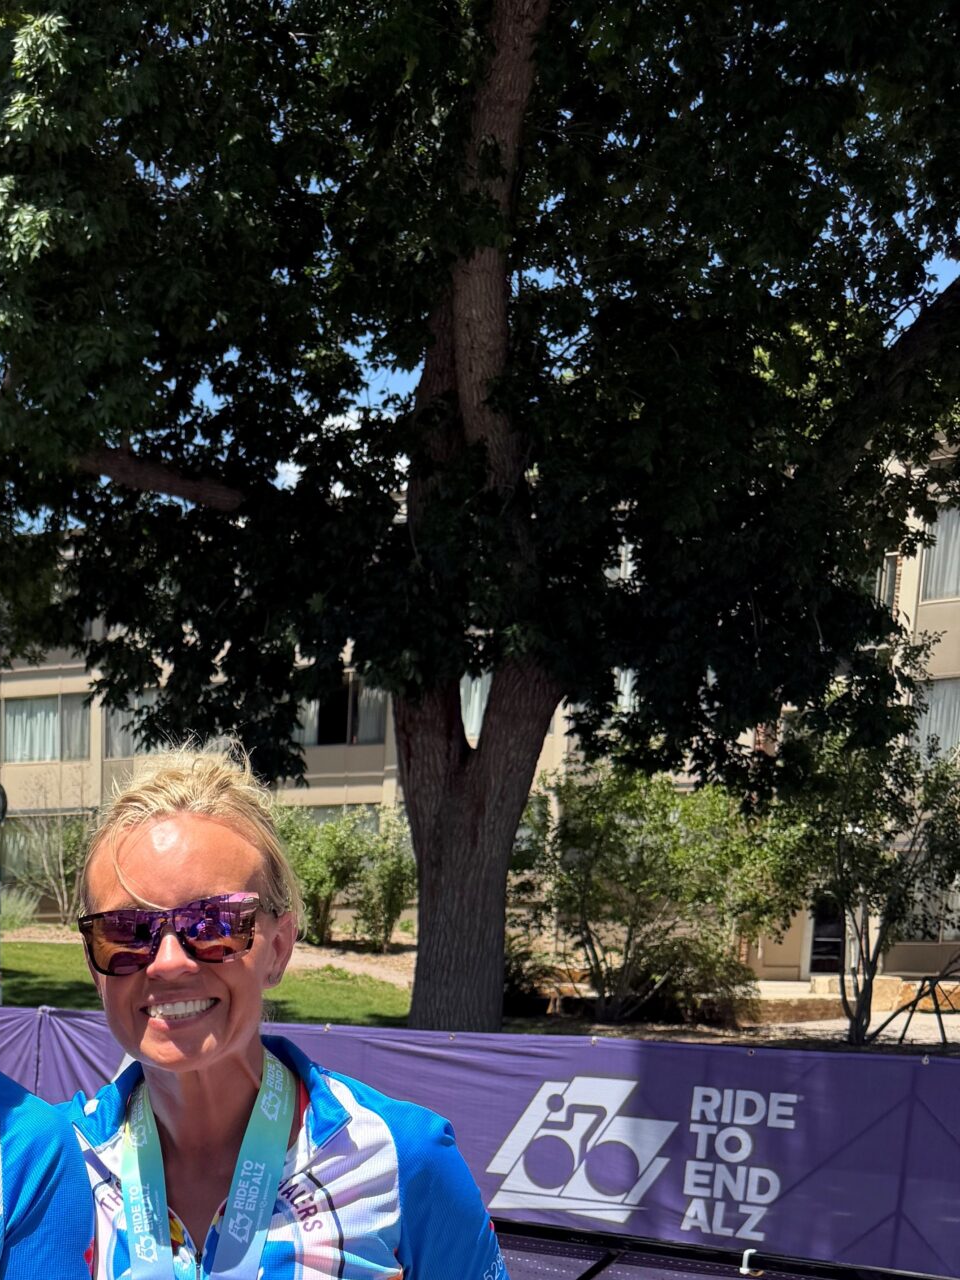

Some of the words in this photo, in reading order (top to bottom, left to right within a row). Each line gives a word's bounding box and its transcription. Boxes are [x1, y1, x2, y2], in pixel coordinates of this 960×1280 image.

[266, 1062, 276, 1088] RIDE
[274, 1069, 284, 1092] END
[690, 1086, 798, 1129] RIDE
[689, 1123, 752, 1163] TO
[240, 1160, 254, 1178] TO
[245, 1187, 259, 1211] END
[252, 1162, 266, 1185] ALZ
[683, 1160, 781, 1205] END
[128, 1186, 139, 1204] TO
[233, 1182, 249, 1209] RIDE
[279, 1182, 324, 1232] ALERS
[131, 1204, 143, 1234] RIDE
[680, 1197, 768, 1242] ALZ
